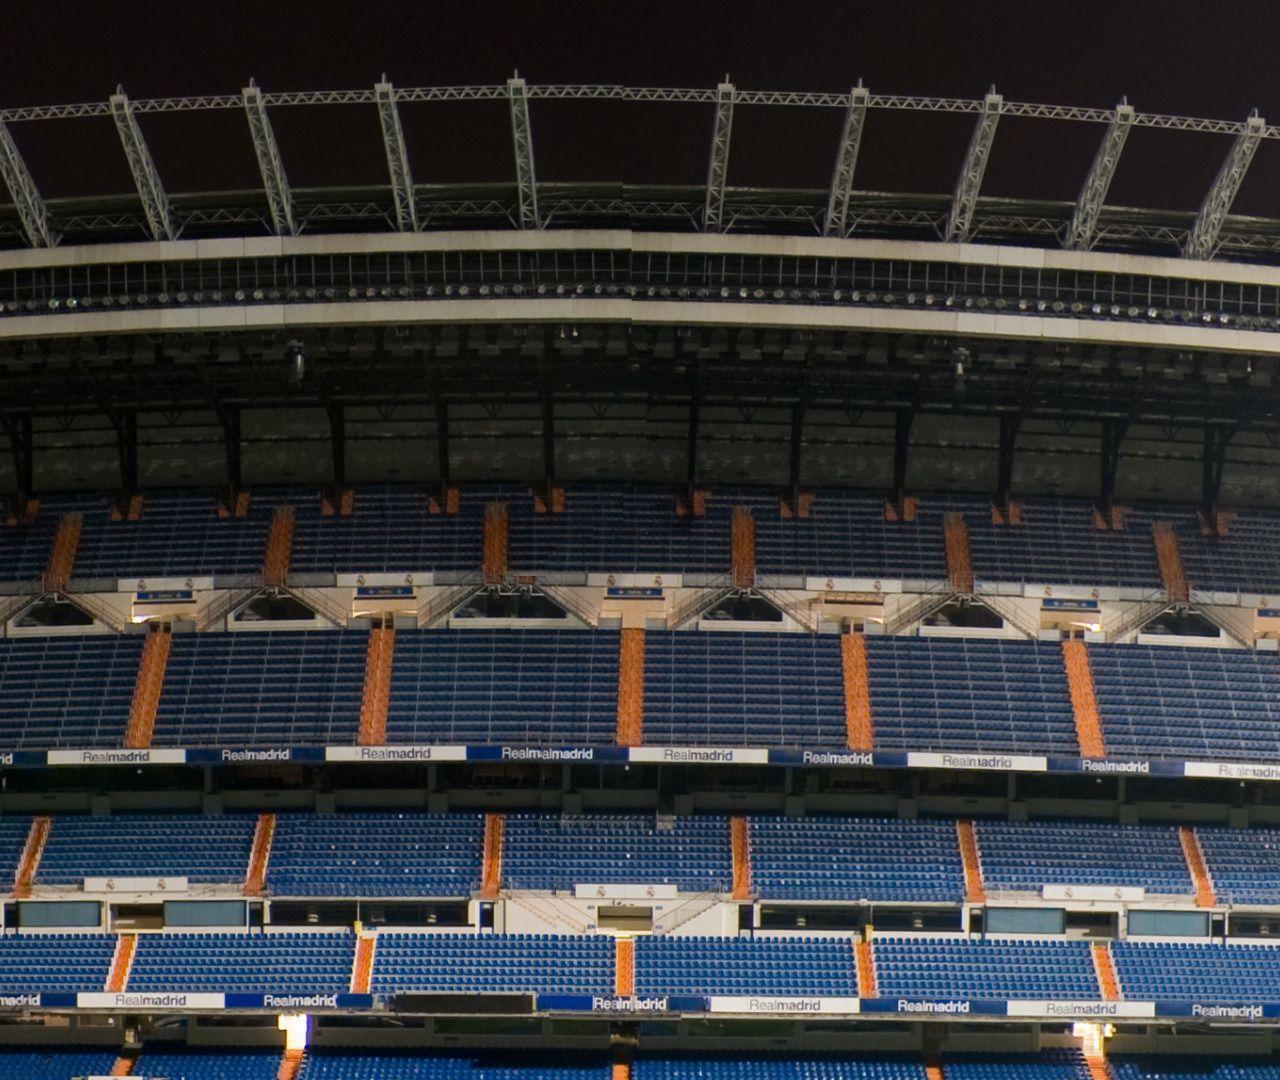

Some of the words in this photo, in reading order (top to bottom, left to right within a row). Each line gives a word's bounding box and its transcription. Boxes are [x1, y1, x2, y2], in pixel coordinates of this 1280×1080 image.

[83, 751, 150, 763] Realmadrid
[222, 749, 290, 761] Realmadrid
[361, 748, 431, 760] Realmadrid
[664, 749, 733, 761] Realmadrid
[803, 751, 873, 765] Realmadrid
[1082, 760, 1149, 774] Realmadrid
[115, 994, 187, 1006] Realmadrid
[264, 994, 336, 1007] Realmadrid
[749, 998, 821, 1011] Realmadrid
[898, 1000, 970, 1012] Realmadrid
[1046, 1003, 1117, 1015] Realmadrid
